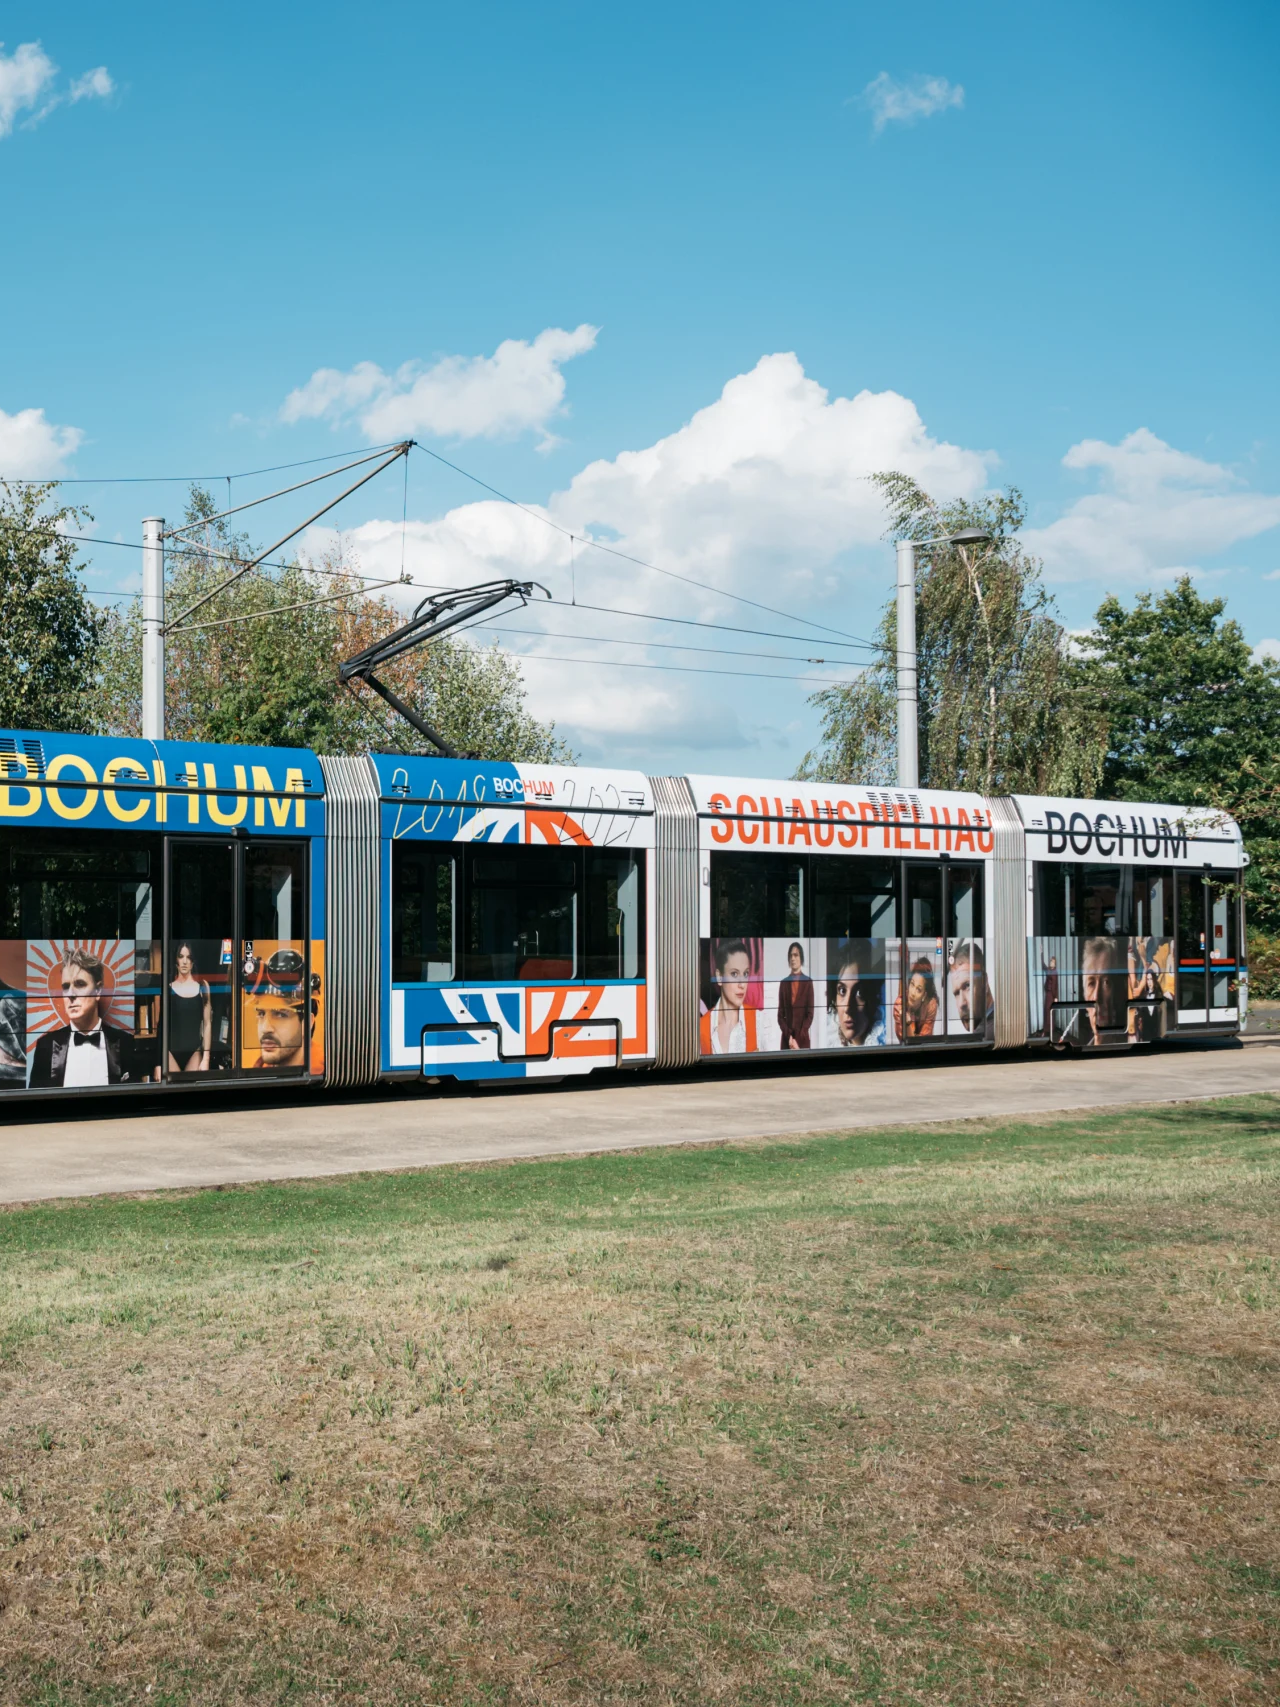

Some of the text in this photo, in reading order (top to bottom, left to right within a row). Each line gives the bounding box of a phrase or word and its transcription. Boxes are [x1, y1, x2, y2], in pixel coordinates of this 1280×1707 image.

[392, 767, 646, 846] 2018 BOCHUM 2027
[1044, 810, 1188, 859] BOCHUM
